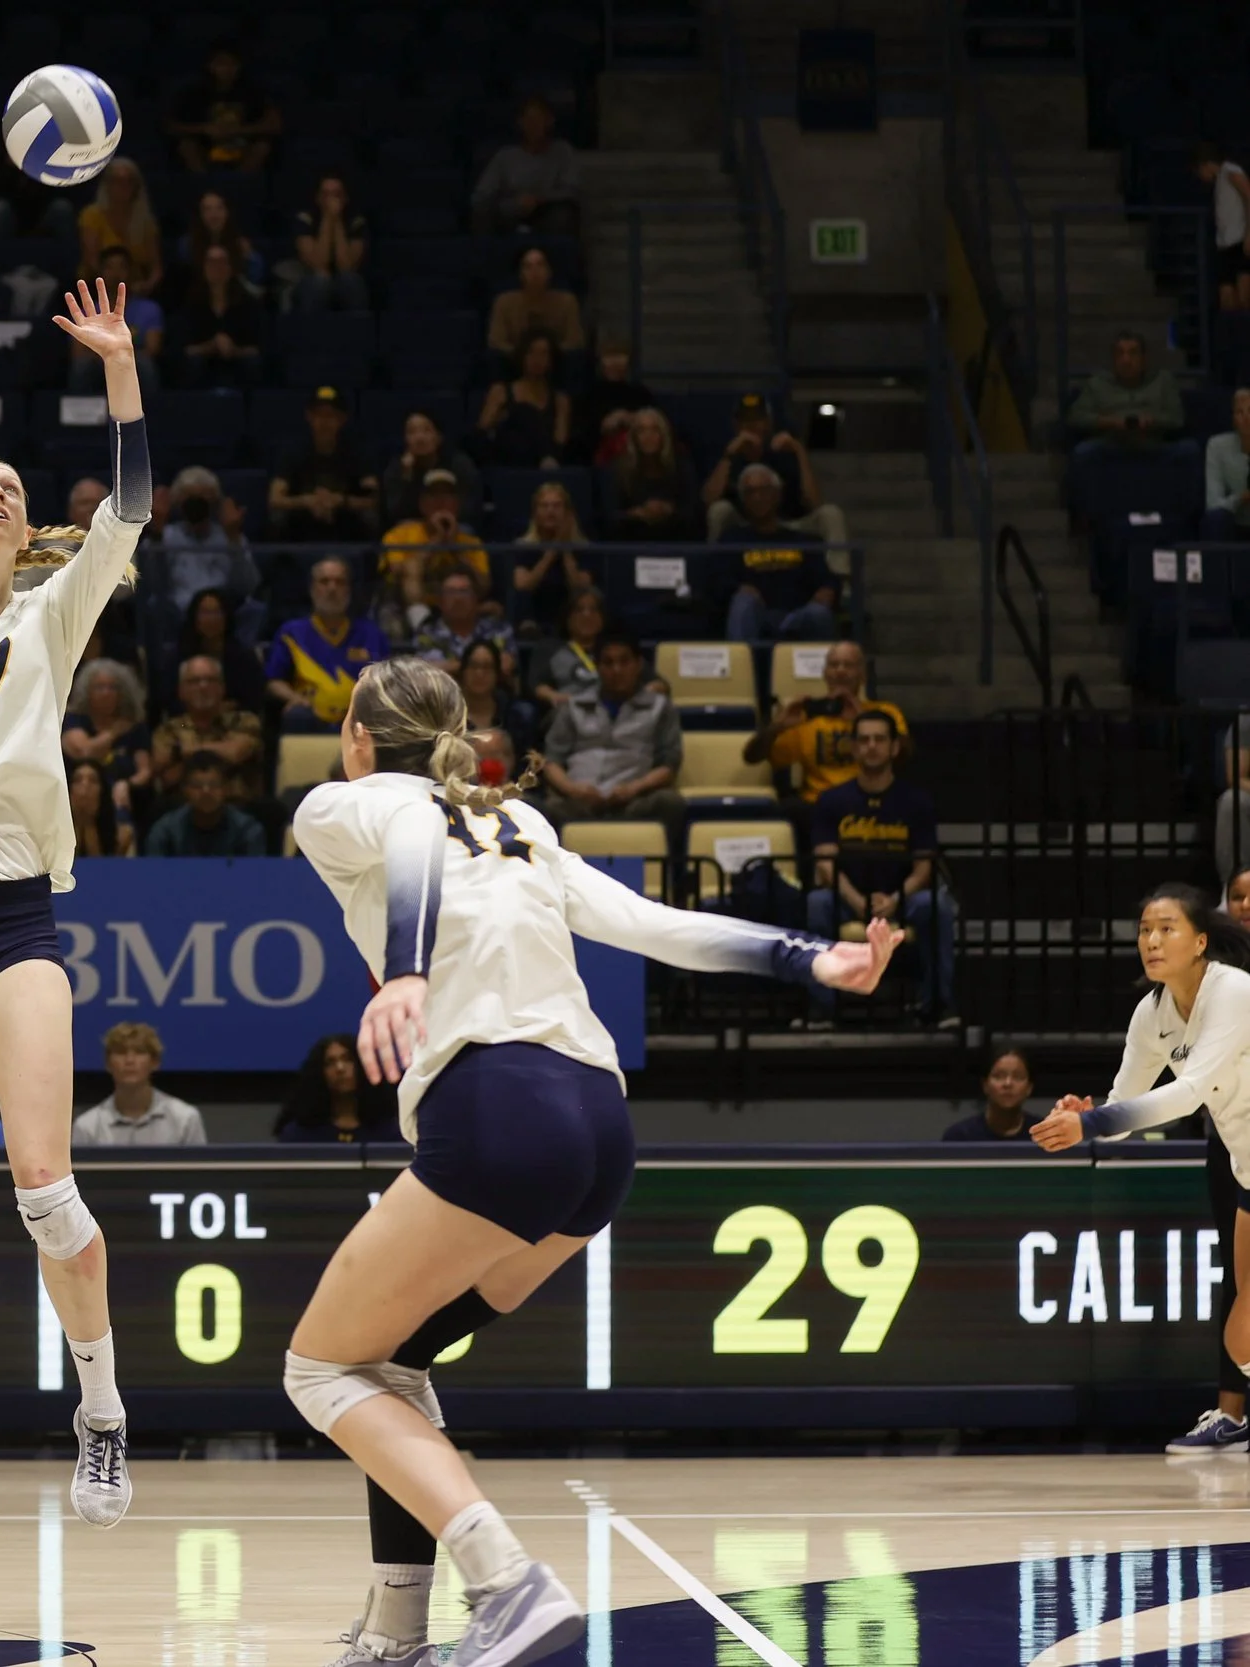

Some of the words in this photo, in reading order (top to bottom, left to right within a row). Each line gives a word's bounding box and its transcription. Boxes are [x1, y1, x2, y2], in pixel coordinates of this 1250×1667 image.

[55, 920, 326, 1008] BMO
[150, 1193, 267, 1239] TOL
[174, 1264, 243, 1364] 0
[711, 1205, 920, 1354] 29
[1018, 1229, 1225, 1323] CALIF
